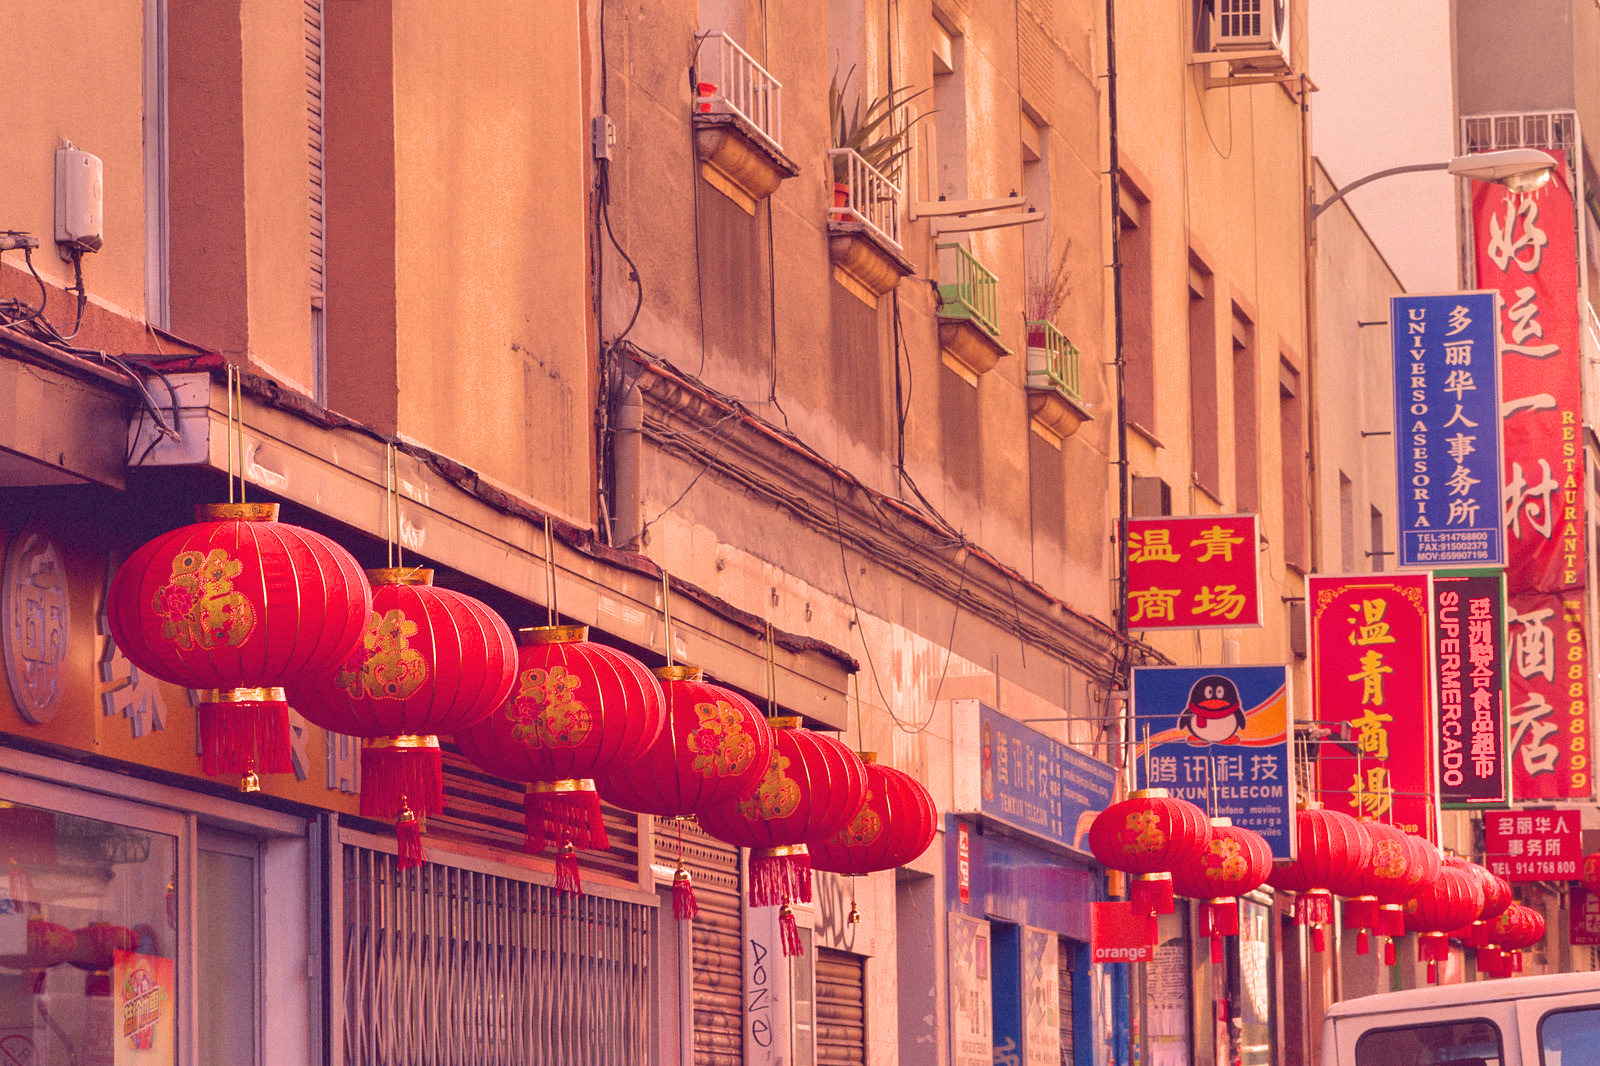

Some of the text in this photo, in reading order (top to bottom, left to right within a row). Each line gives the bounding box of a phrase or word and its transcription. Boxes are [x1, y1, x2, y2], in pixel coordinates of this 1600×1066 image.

[1408, 309, 1431, 527] UNIVERSO ASESORIA
[1443, 305, 1481, 527] 多丽华人事务所
[1561, 411, 1578, 585] RESTAURANTE
[1128, 525, 1245, 563] 温青
[1128, 584, 1246, 622] 商场
[1439, 591, 1463, 786] SUPERMERCADO
[1150, 754, 1278, 782] 腾讯科技
[1167, 785, 1283, 799] NXUN TELECOM
[1237, 818, 1281, 826] recarga
[1498, 816, 1570, 835] 多丽华人
[1508, 838, 1561, 857] 事务所
[1516, 862, 1534, 874] 914
[1537, 861, 1555, 873] 768
[1557, 861, 1576, 873] 800
[1095, 947, 1147, 961] orange
